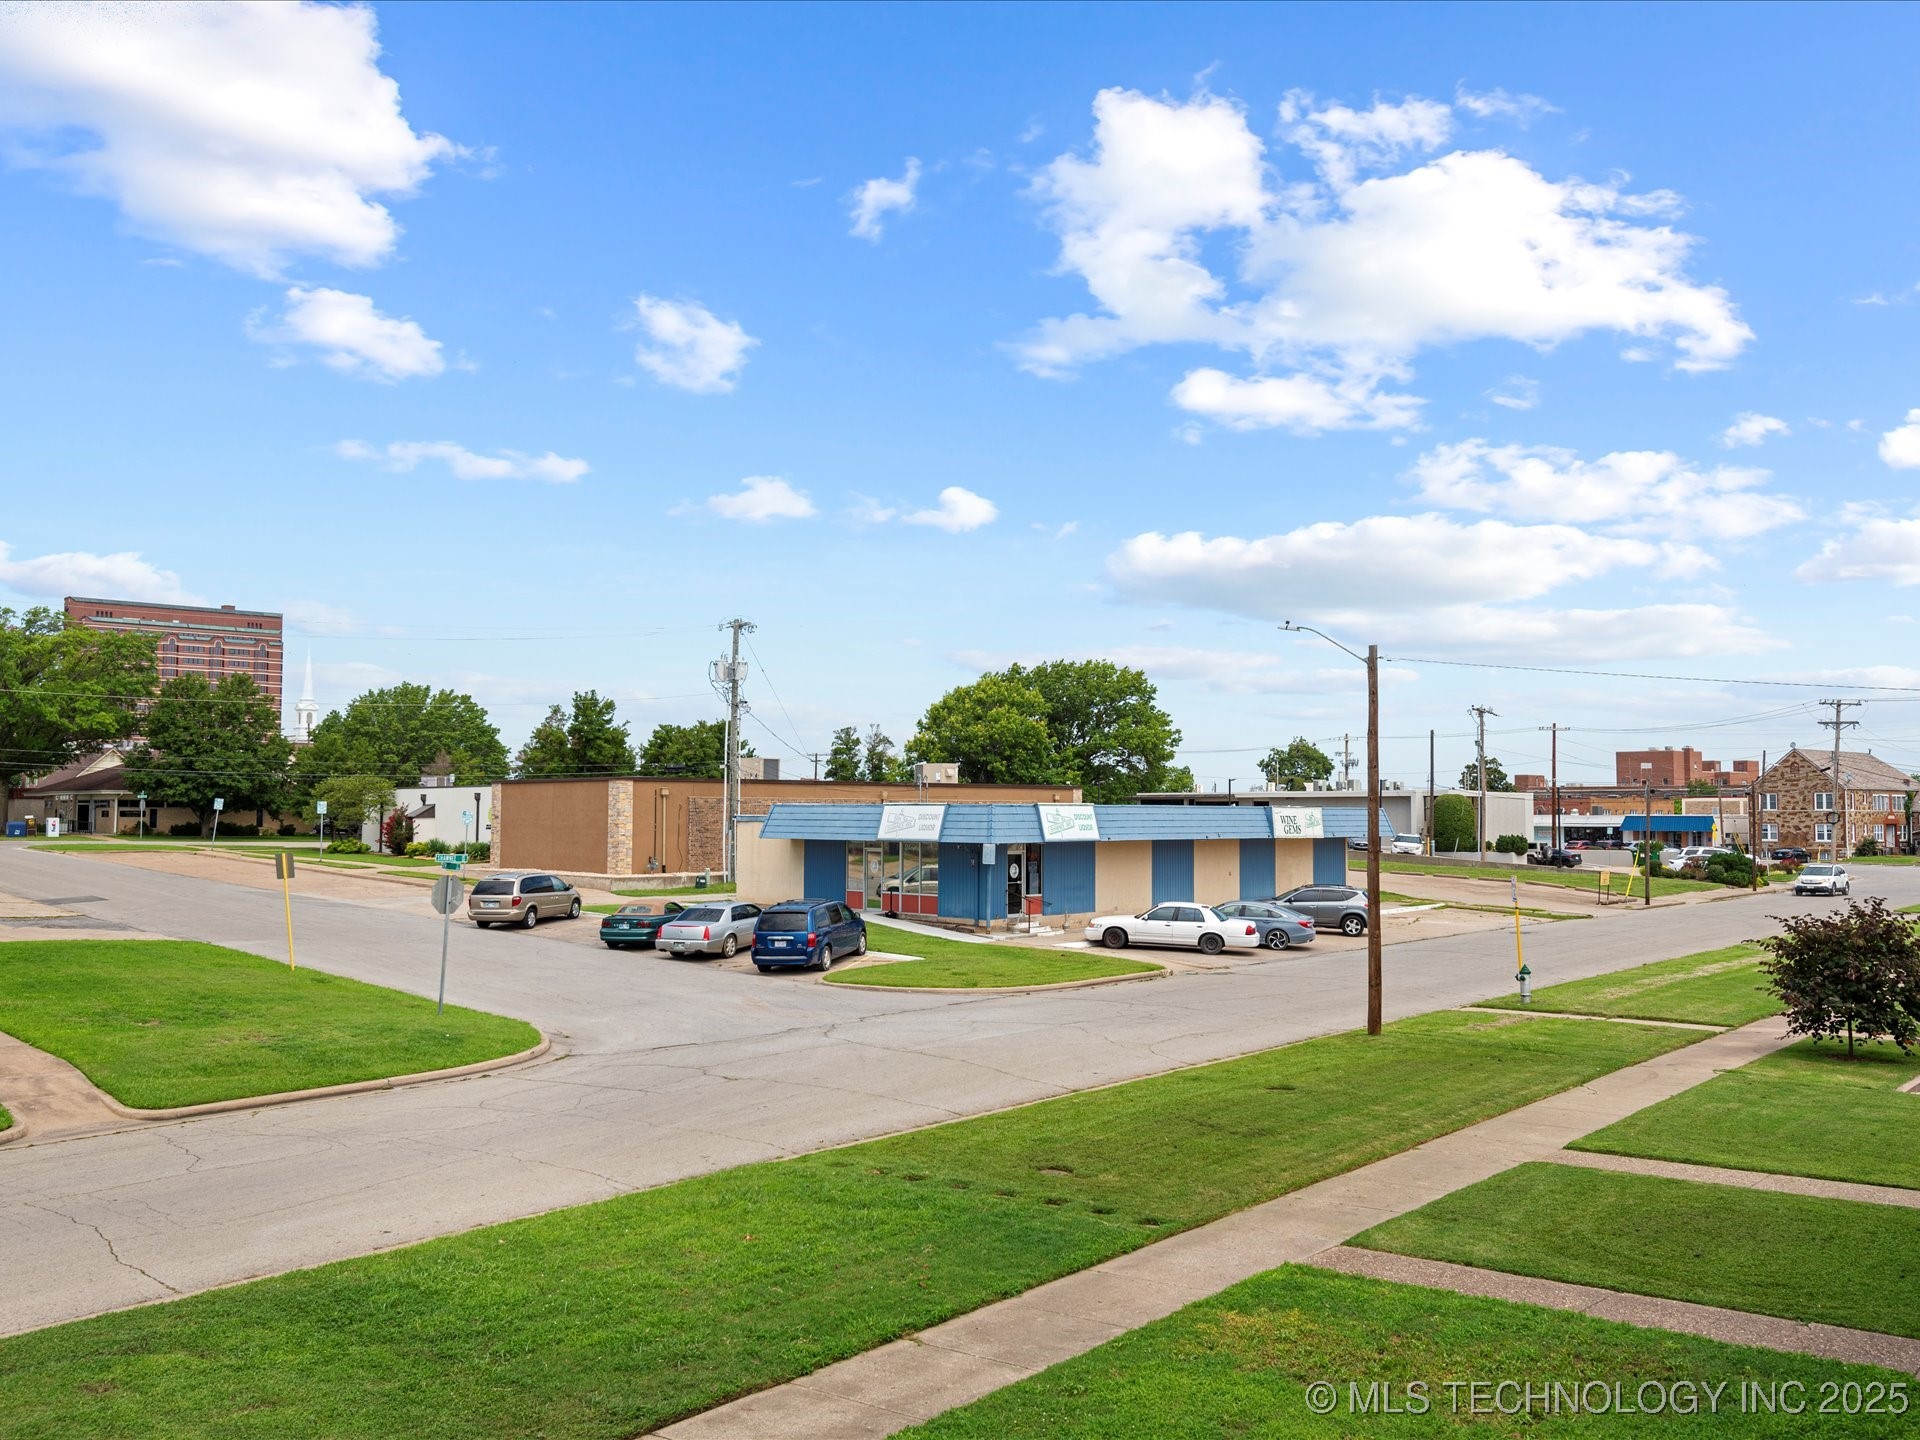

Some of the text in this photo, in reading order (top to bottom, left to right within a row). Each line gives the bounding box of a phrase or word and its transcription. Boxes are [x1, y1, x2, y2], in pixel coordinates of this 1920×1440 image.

[1073, 813, 1093, 821] DISCOUNT
[1280, 815, 1298, 824] WINE
[1078, 823, 1094, 831] LIQUOR
[1283, 825, 1302, 834] GEMS
